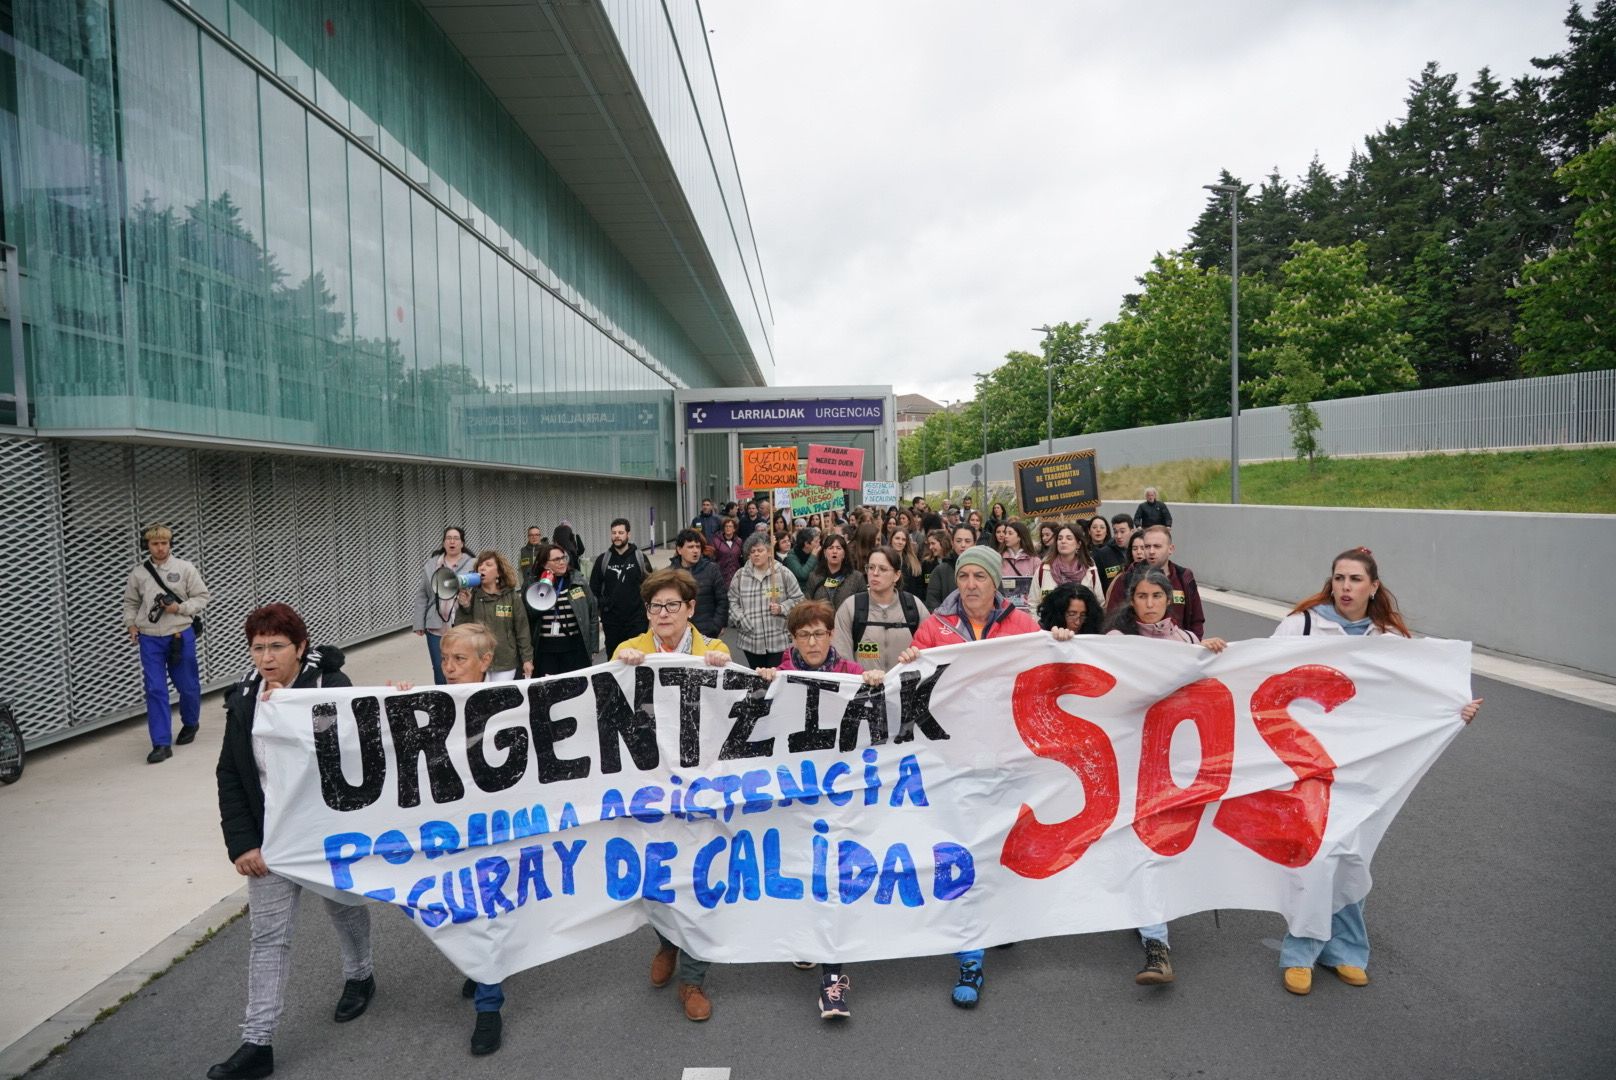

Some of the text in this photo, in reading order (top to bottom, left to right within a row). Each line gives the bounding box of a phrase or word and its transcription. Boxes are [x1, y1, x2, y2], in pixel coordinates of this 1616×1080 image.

[731, 406, 881, 420] LARRIALDIAK URGENCIAS
[748, 450, 796, 464] GUZTION
[754, 462, 796, 473] OSASUNA
[810, 467, 857, 478] OSASUNA LORTU
[749, 472, 798, 486] ARRISKUAN
[824, 479, 840, 489] ARTE
[858, 643, 878, 652] SOS
[312, 662, 950, 813] URGENTZIAK
[1000, 662, 1357, 880] SOS
[604, 835, 679, 907] DE
